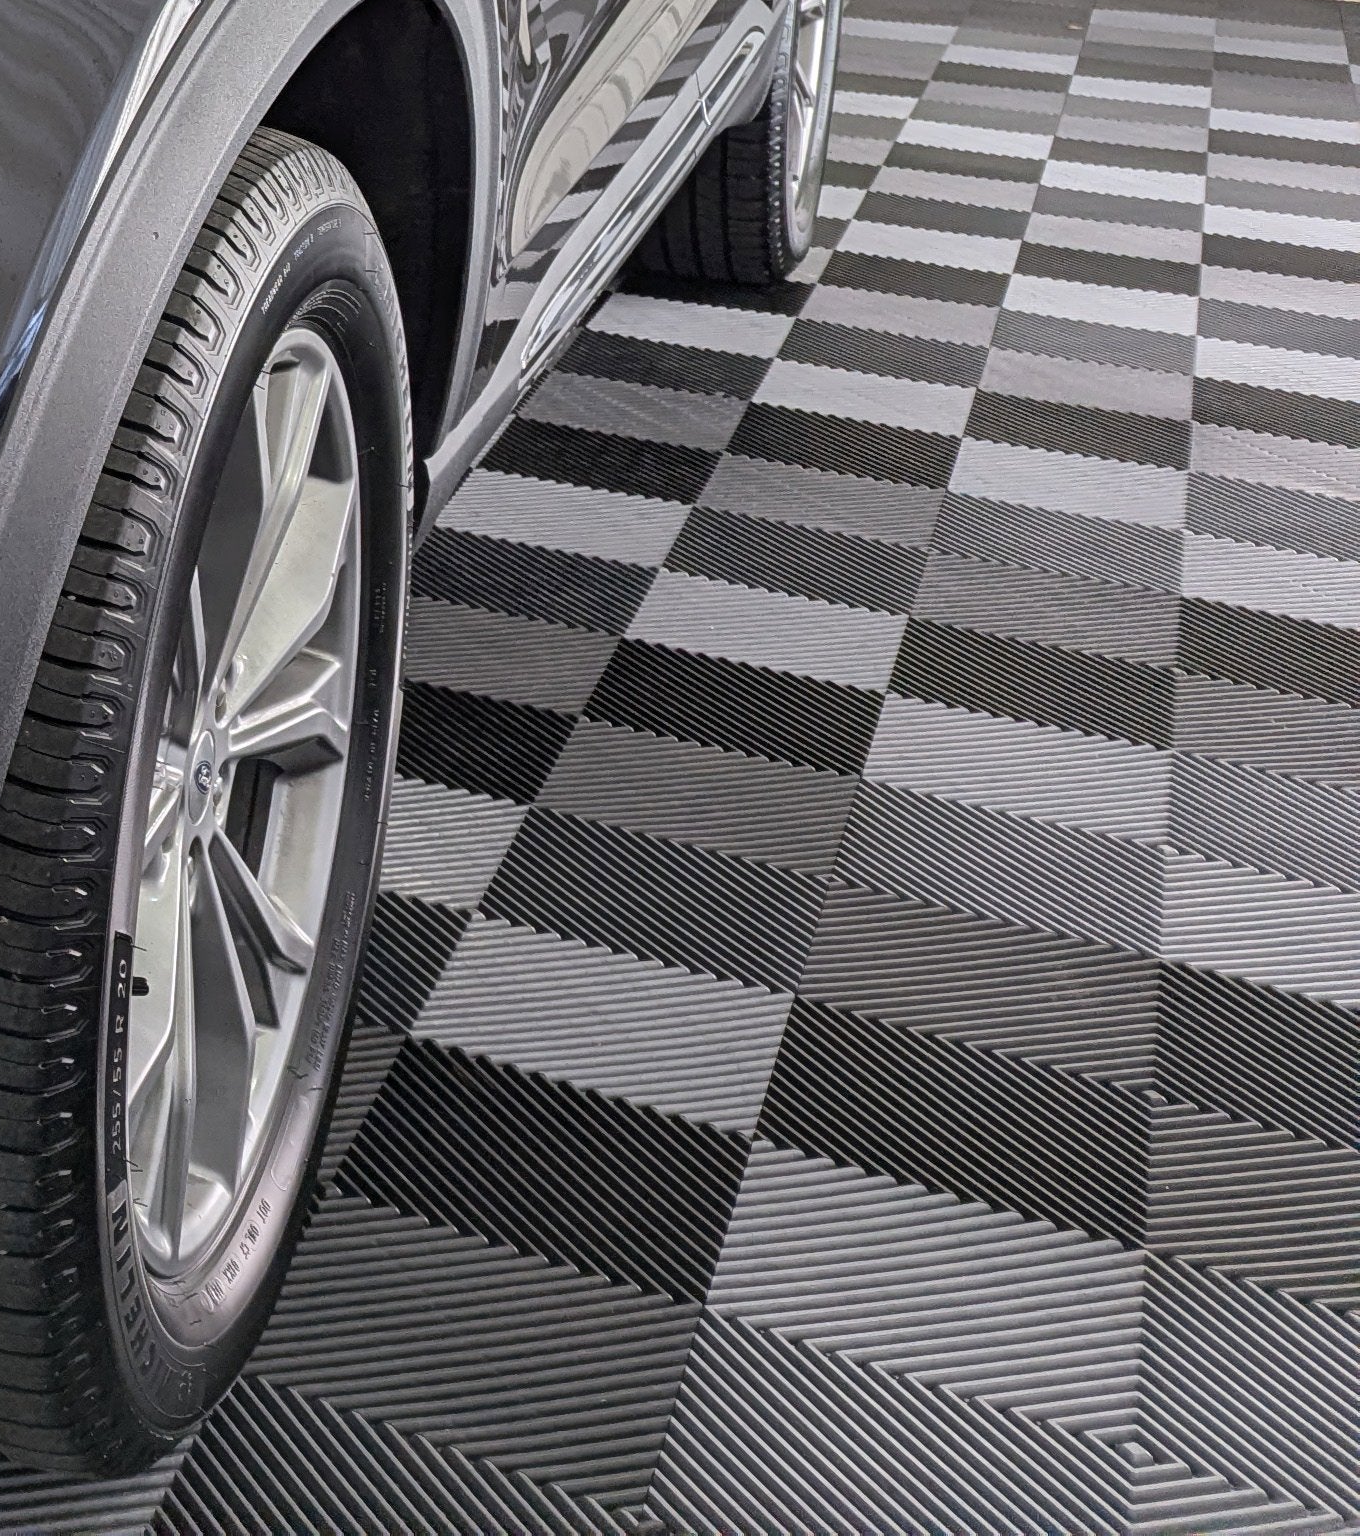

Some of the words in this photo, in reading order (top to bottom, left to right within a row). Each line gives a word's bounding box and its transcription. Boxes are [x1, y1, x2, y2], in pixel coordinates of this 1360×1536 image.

[118, 959, 127, 998] 20
[116, 1015, 124, 1033] R
[112, 1047, 121, 1155] 255/55
